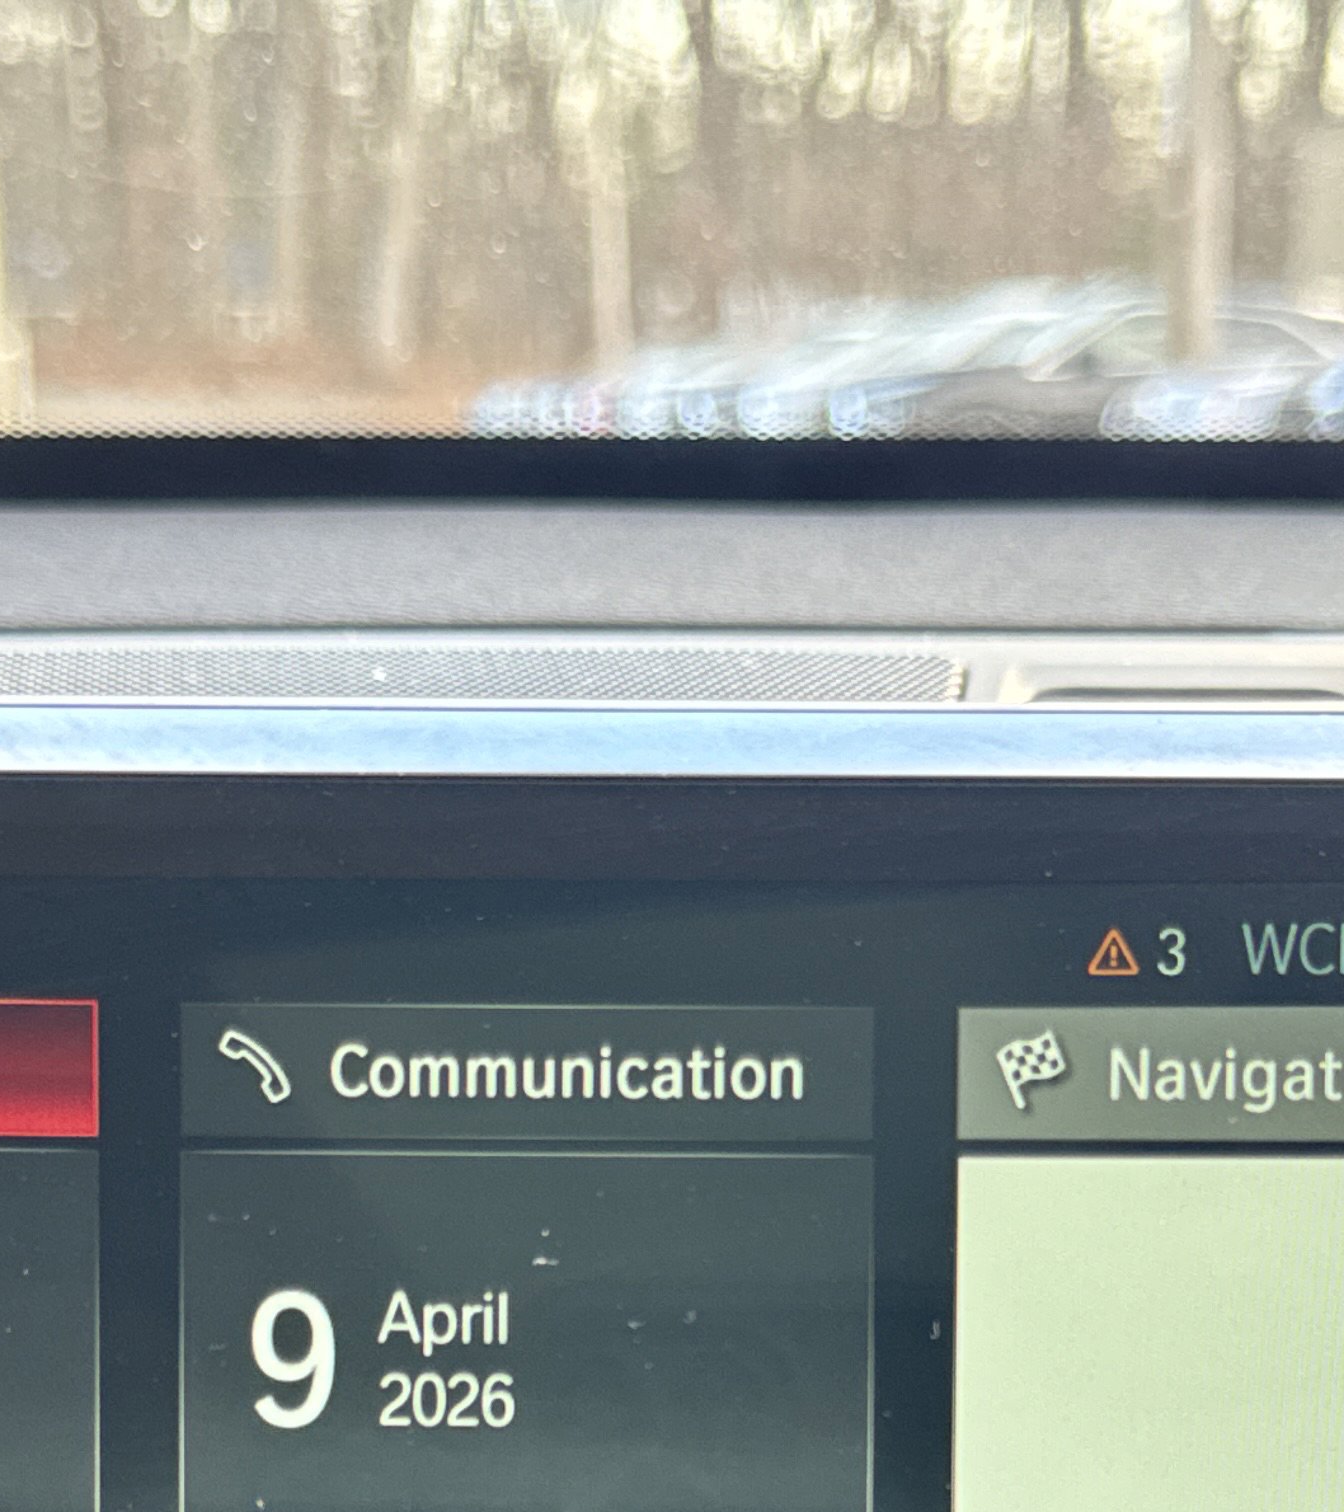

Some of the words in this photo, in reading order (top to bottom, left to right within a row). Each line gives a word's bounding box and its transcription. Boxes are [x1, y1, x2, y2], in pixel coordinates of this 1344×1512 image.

[1156, 926, 1188, 977] 3
[329, 1042, 804, 1101] Communication
[376, 1288, 510, 1358] April
[249, 1287, 338, 1430] 9
[378, 1371, 517, 1429] 2026
